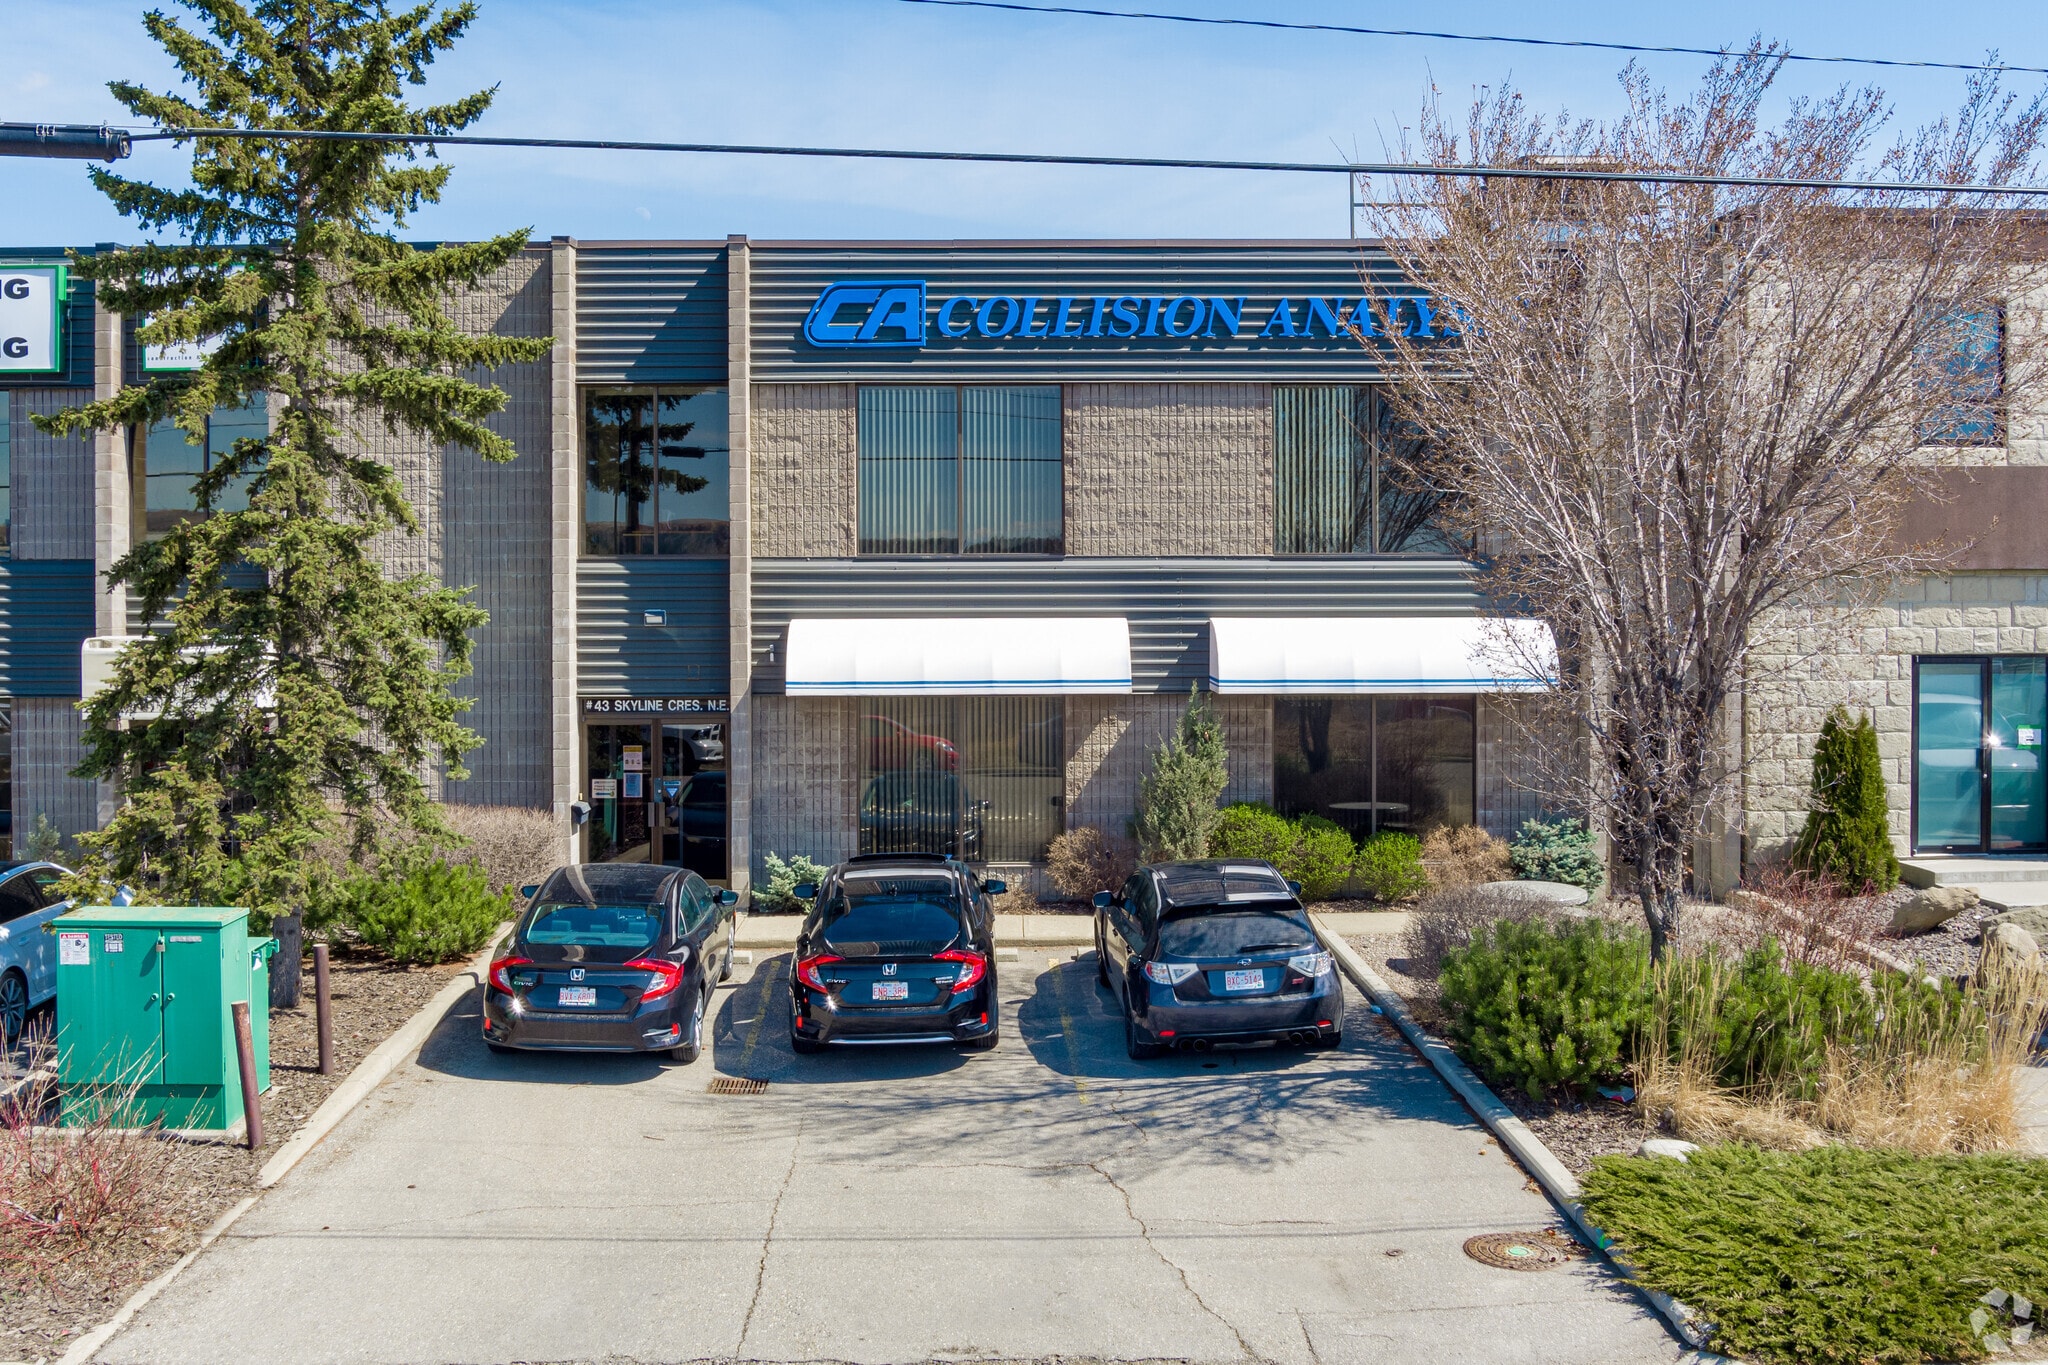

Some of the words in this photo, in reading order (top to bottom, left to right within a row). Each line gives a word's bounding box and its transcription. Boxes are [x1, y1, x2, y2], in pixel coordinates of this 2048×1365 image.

[0, 278, 29, 299] G
[809, 288, 921, 341] CA
[937, 295, 1248, 338] COLLISION
[1258, 296, 1482, 339] ANALY
[0, 336, 29, 359] G
[614, 700, 663, 712] SKYLINE
[667, 700, 703, 712] CRES.
[707, 700, 730, 712] N.E.
[1226, 975, 1262, 986] BXC-5142
